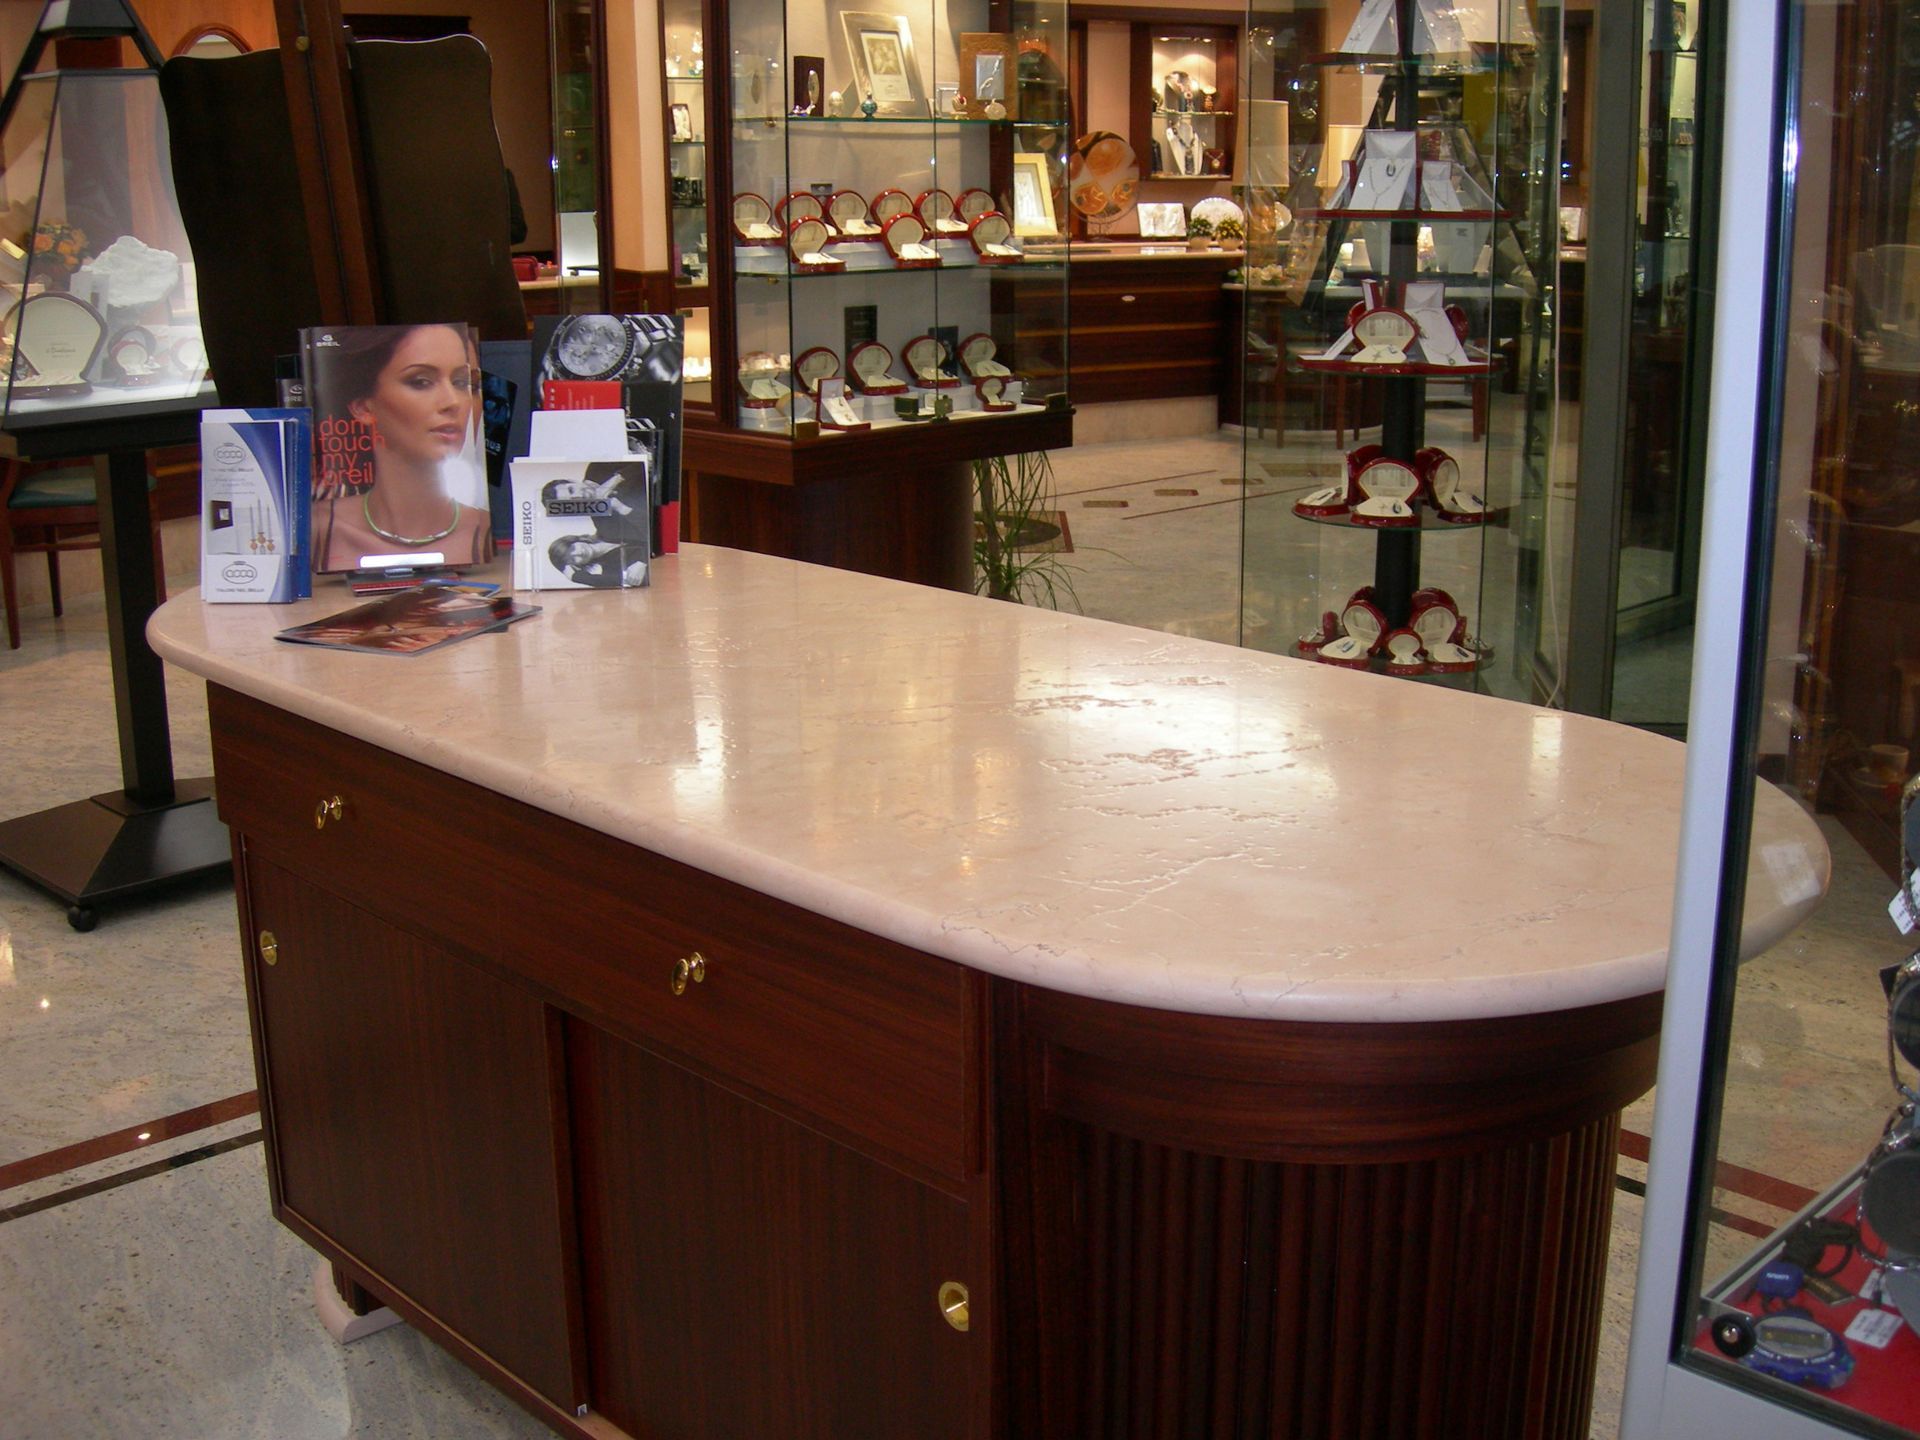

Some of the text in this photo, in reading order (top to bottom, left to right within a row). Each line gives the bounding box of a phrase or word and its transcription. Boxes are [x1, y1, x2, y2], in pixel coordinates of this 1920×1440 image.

[319, 432, 386, 453] touch
[322, 452, 358, 474] my
[549, 500, 609, 515] SEIKO
[522, 501, 533, 545] SEIKO
